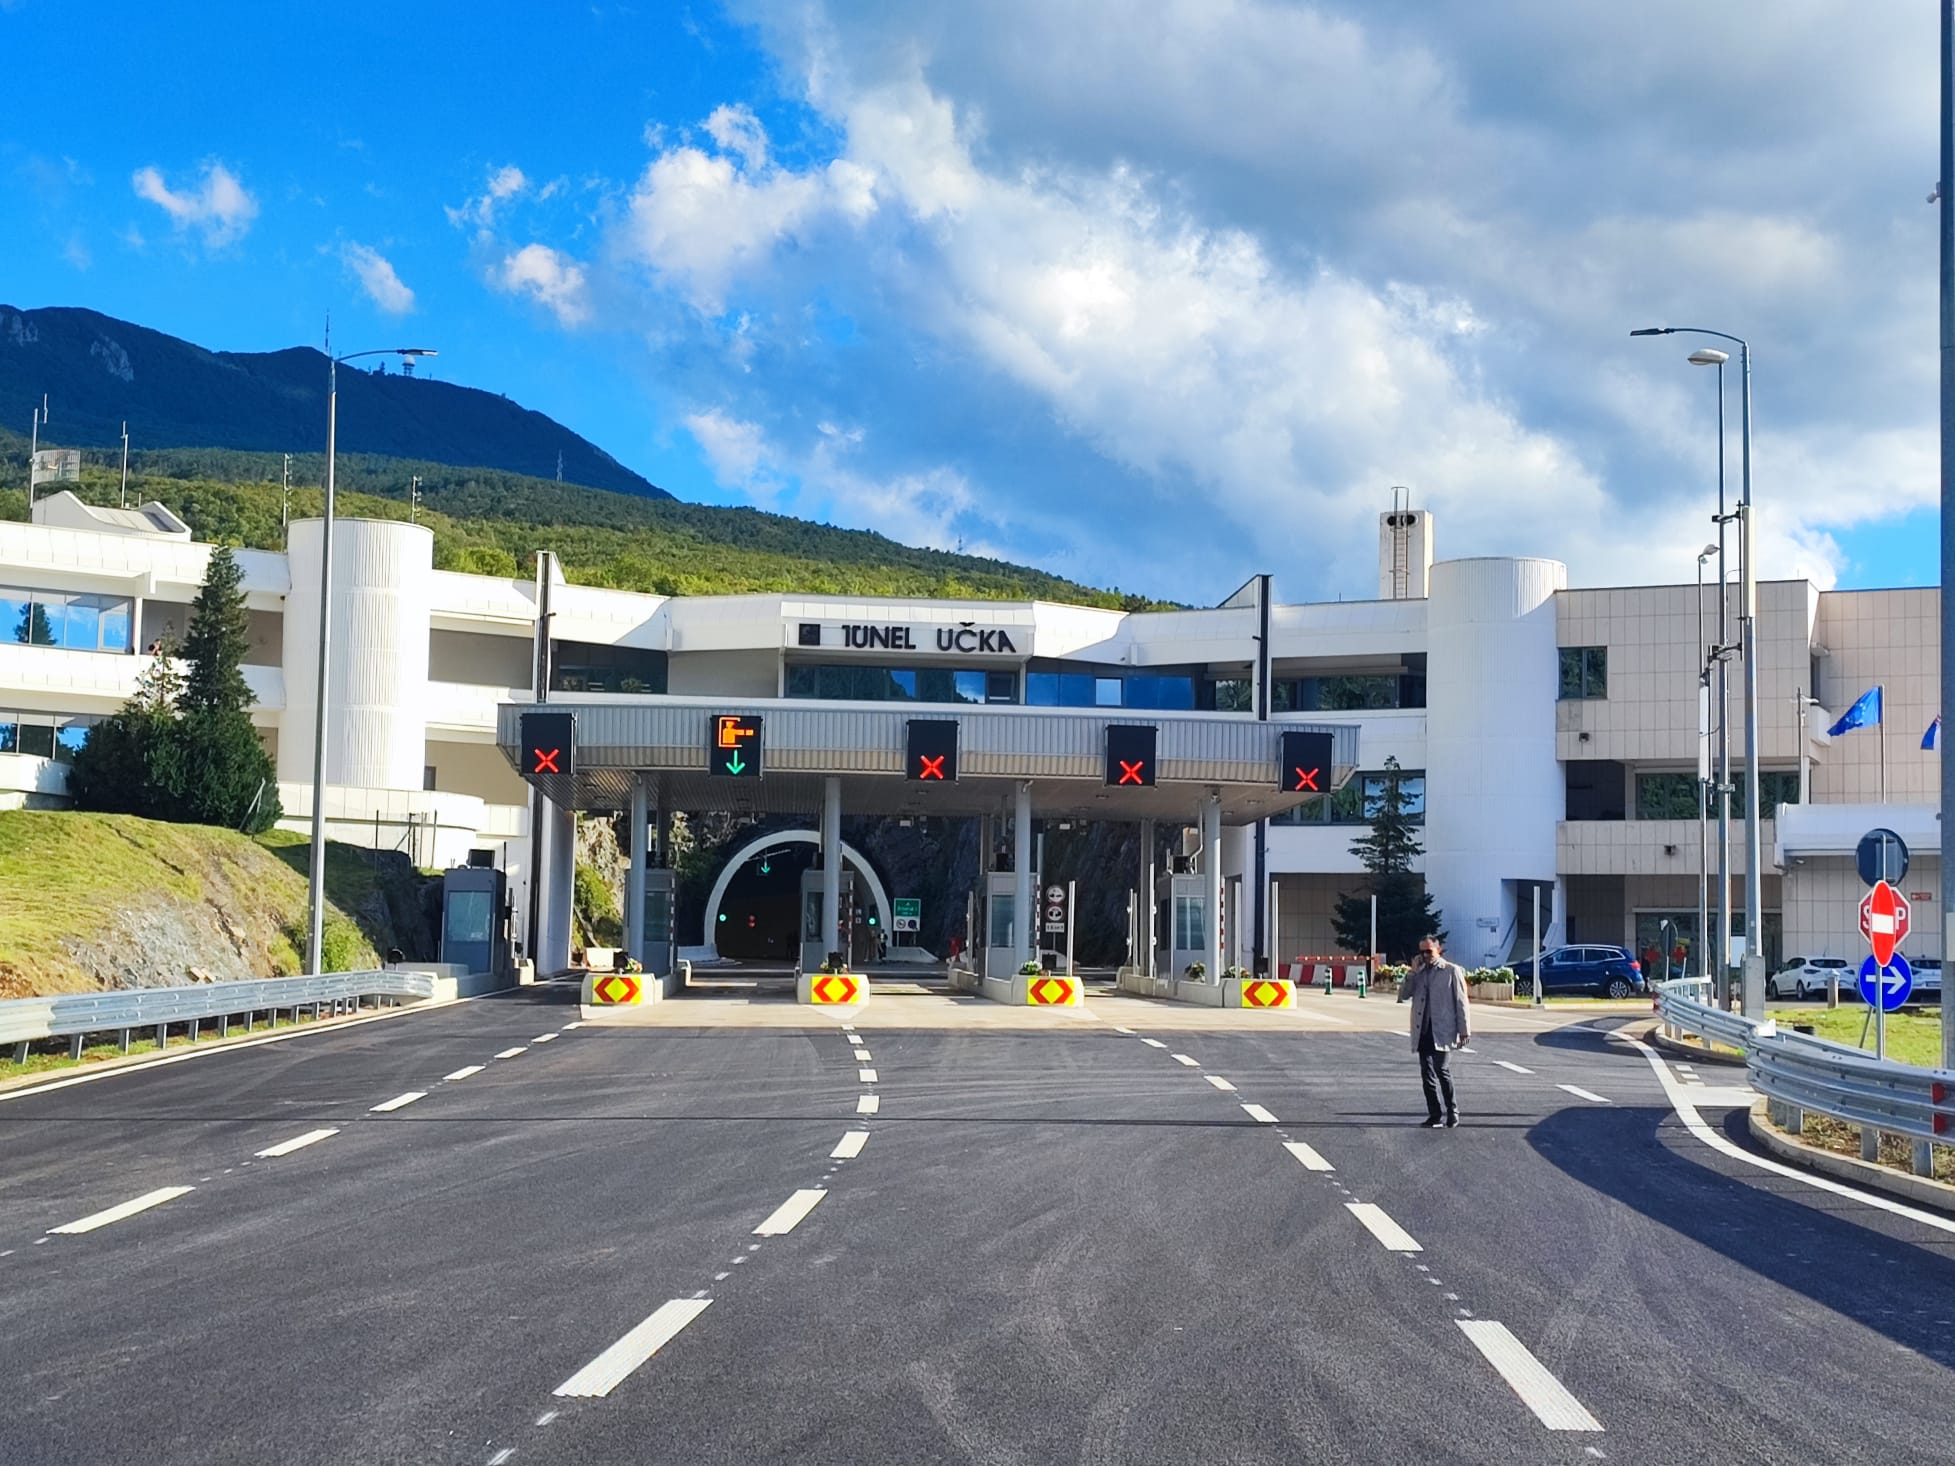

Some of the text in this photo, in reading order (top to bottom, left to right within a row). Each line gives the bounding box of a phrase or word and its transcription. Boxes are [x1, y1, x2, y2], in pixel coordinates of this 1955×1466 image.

[842, 622, 1016, 653] TUNEL UČKA
[1863, 905, 1906, 930] SP
